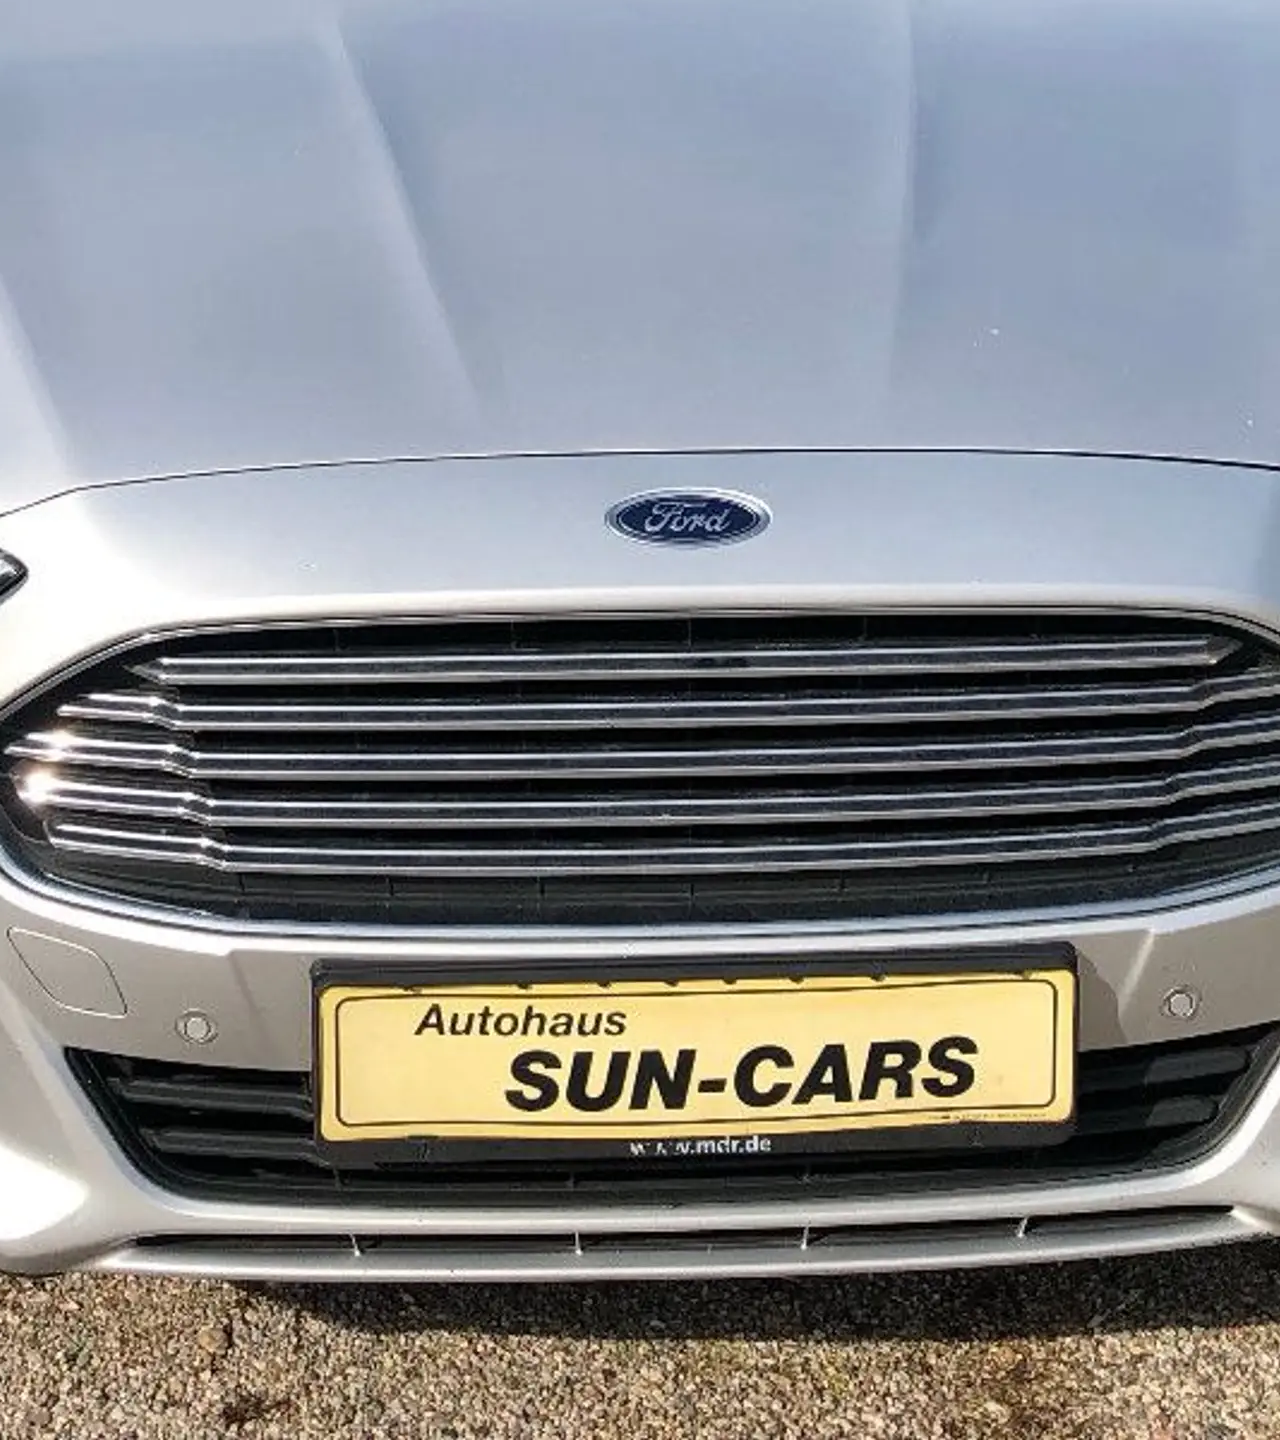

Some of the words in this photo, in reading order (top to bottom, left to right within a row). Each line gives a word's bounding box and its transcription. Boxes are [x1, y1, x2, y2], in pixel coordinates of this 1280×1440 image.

[644, 501, 732, 532] Ford
[414, 1002, 627, 1039] Autohaus
[504, 1035, 978, 1114] SUN-CARS
